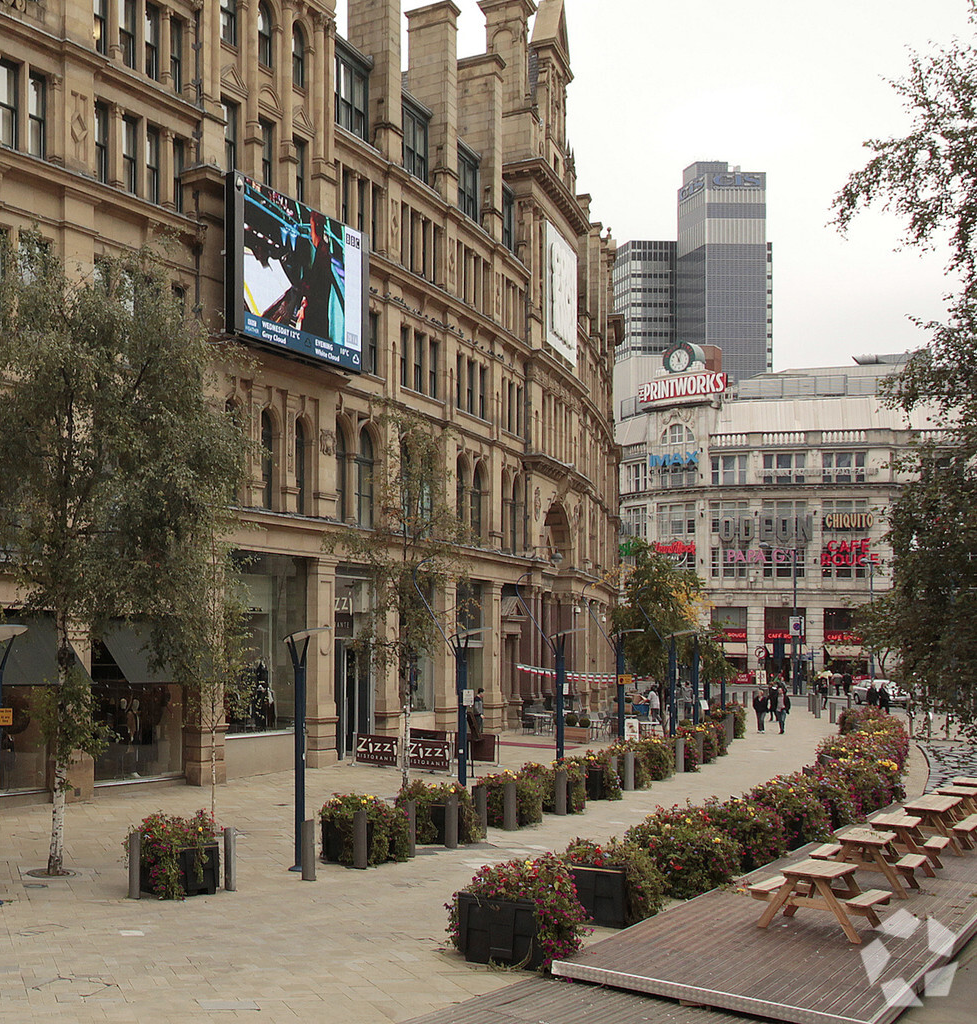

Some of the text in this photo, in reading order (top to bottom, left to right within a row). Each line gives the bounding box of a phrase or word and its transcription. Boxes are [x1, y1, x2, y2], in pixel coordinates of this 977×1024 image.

[262, 330, 287, 345] Grey Cloud
[315, 347, 340, 362] White Cloud
[643, 372, 724, 402] PRINTWORKS
[649, 451, 700, 468] IMAX
[719, 515, 813, 543] ODEON
[825, 513, 874, 529] CHIQUITO
[727, 549, 767, 563] PAPA
[820, 553, 881, 567] ROUGE
[356, 737, 397, 756] Zizzi
[409, 742, 450, 761] Zizzi
[410, 758, 449, 767] ISTORANTE
